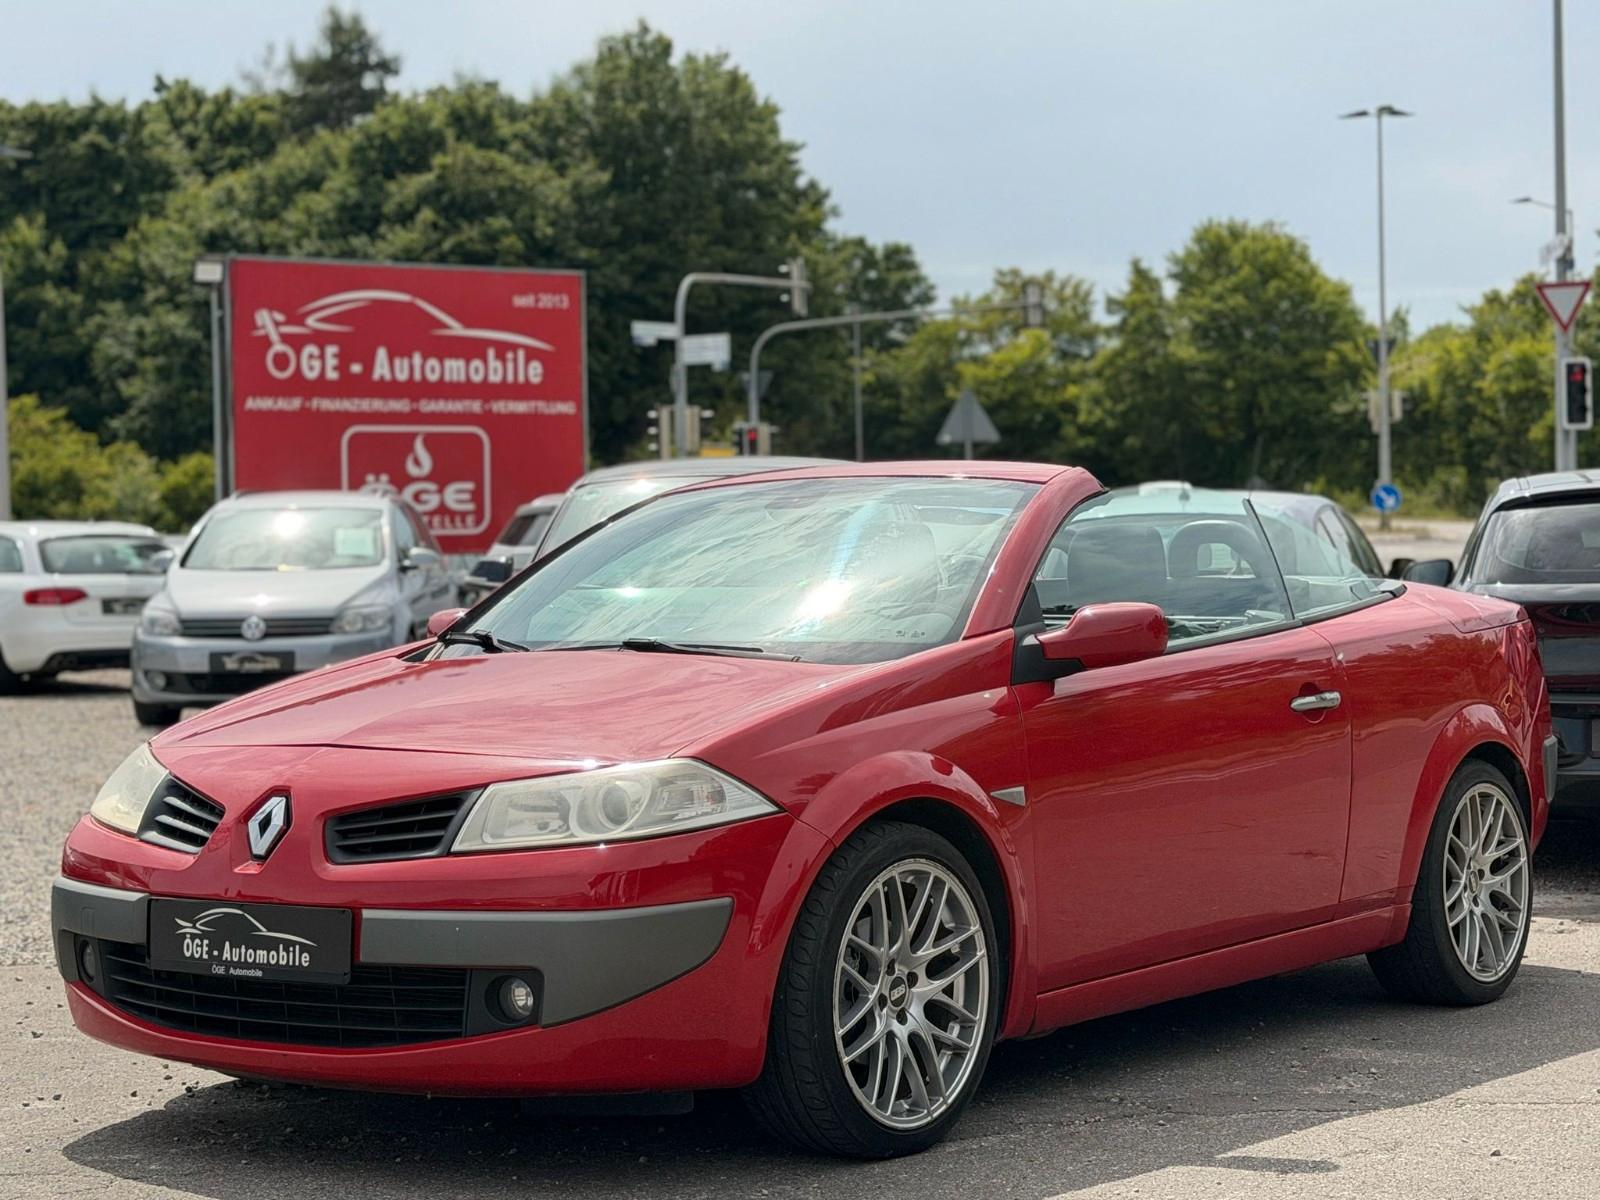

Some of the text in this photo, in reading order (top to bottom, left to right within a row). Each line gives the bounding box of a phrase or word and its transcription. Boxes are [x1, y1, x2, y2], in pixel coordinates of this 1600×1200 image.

[371, 345, 544, 385] Automobile
[222, 940, 310, 967] Automobile
[229, 966, 264, 977] Automobile
